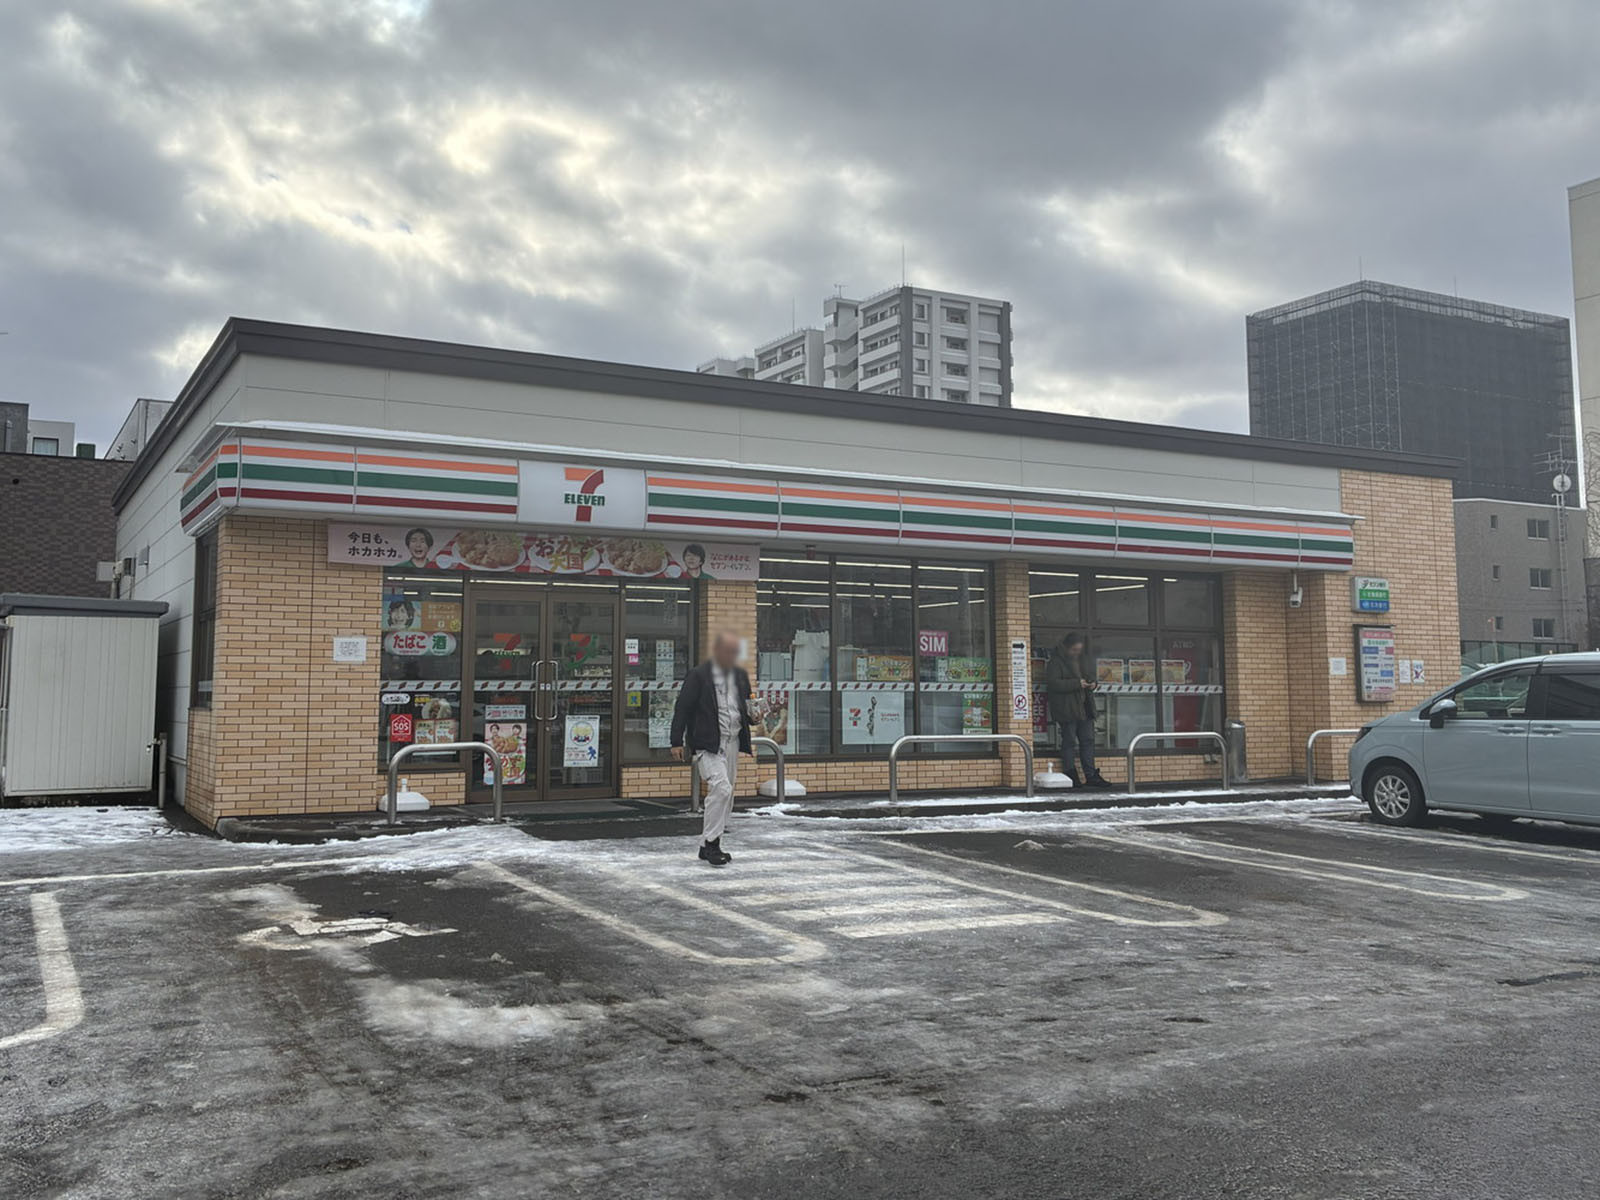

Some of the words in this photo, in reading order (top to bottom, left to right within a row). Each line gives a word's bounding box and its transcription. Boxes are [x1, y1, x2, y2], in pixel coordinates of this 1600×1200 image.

[347, 531, 389, 545] 今日も、
[347, 546, 402, 558] ホカホカ。
[393, 634, 427, 649] たばこ
[432, 635, 447, 650] 酒
[920, 636, 945, 652] SIM
[394, 722, 409, 731] SOS
